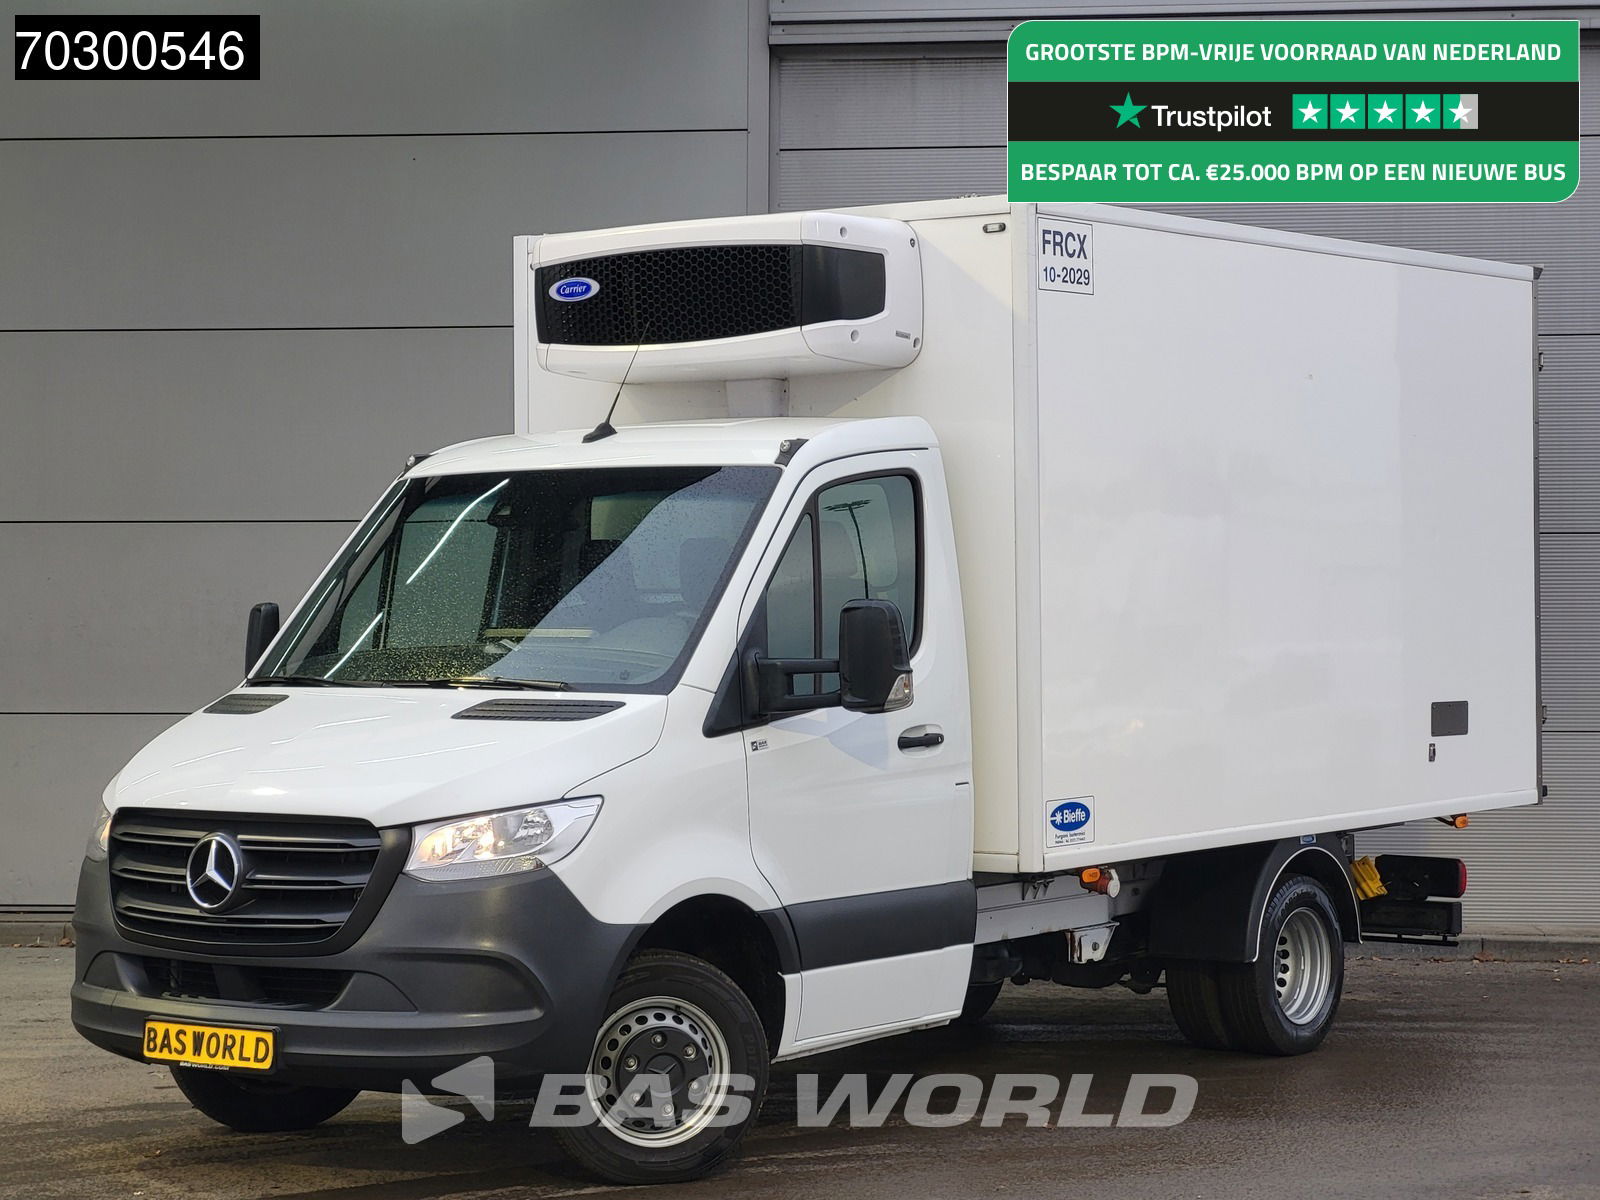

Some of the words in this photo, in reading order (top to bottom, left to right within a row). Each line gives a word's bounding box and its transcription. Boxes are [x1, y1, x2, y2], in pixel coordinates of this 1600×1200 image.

[1042, 229, 1087, 260] FRCX
[1043, 266, 1090, 286] 10-2029
[560, 284, 587, 295] Carrier
[1063, 808, 1086, 824] Bieffe
[146, 1026, 187, 1056] BAS
[192, 1030, 270, 1063] WORLD
